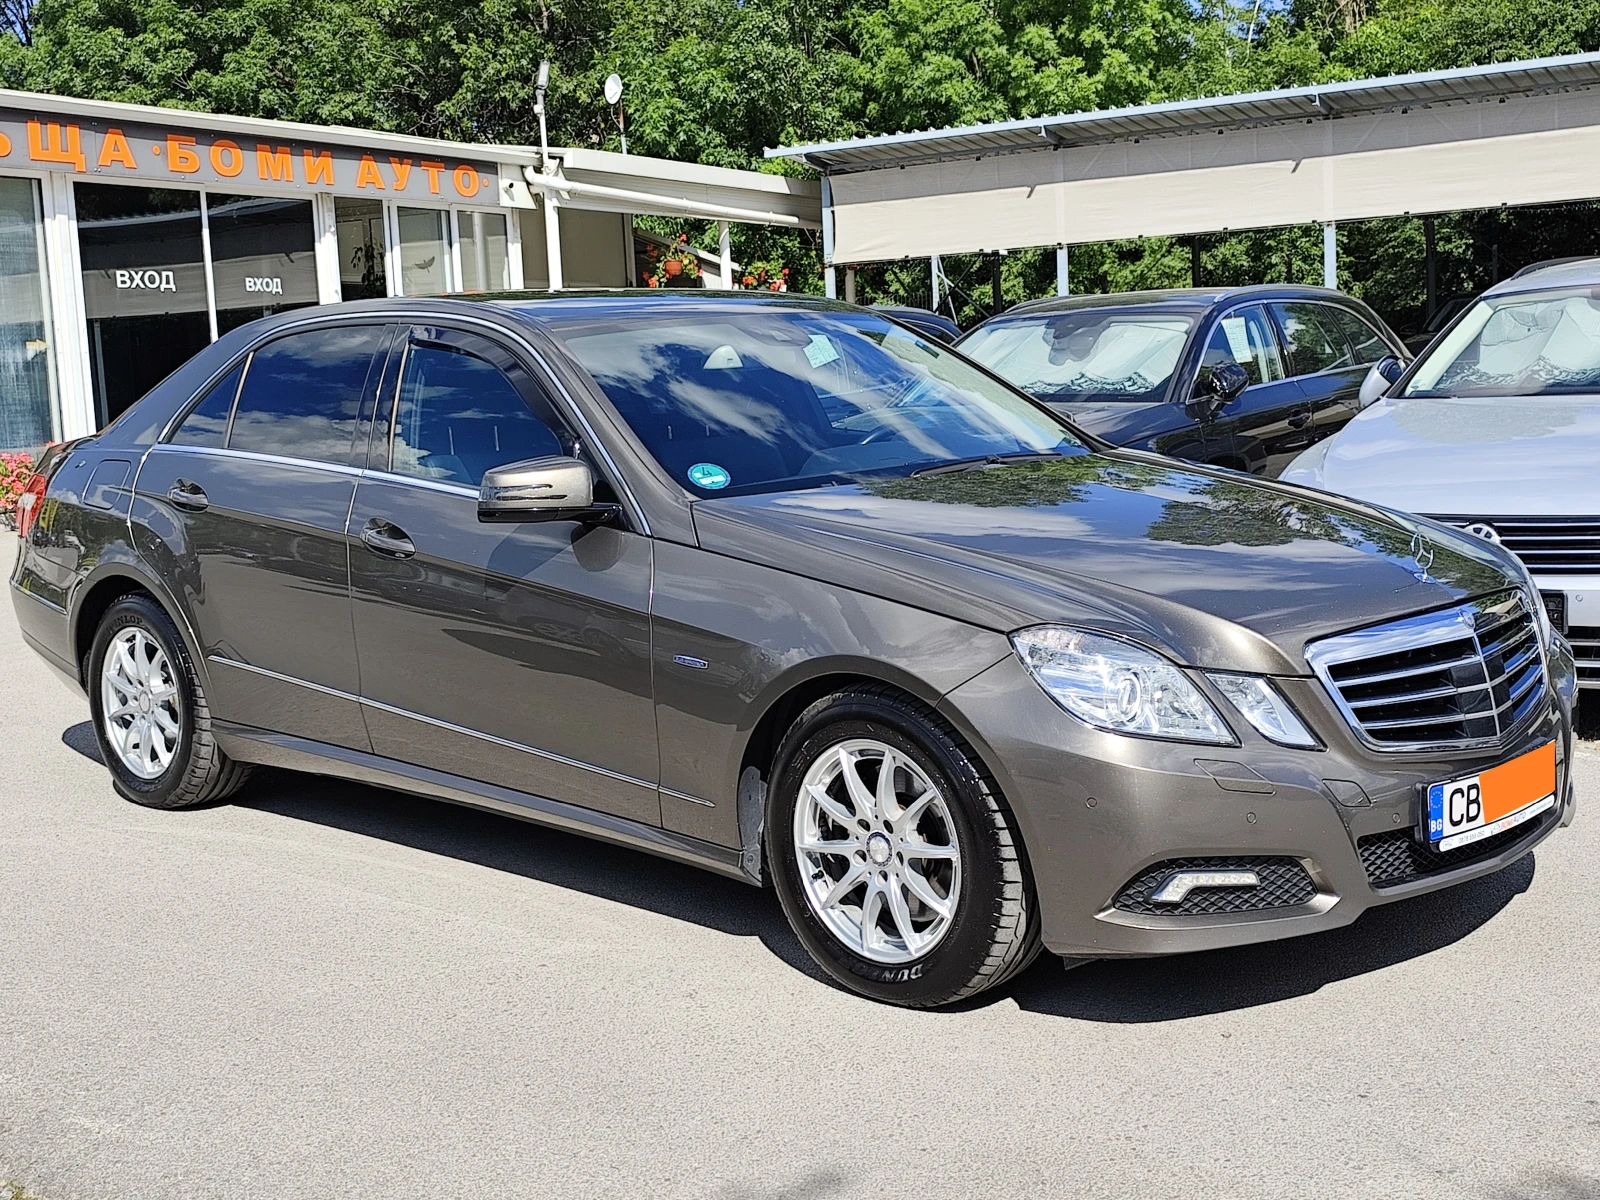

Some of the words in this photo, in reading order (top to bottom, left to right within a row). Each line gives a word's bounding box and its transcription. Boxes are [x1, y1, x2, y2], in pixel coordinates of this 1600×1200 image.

[166, 134, 335, 186] БОМИ
[356, 154, 480, 198] АУТО
[115, 270, 176, 292] ВХОД
[244, 277, 283, 295] ВХОД
[1449, 783, 1481, 827] CB
[1430, 818, 1443, 833] BG
